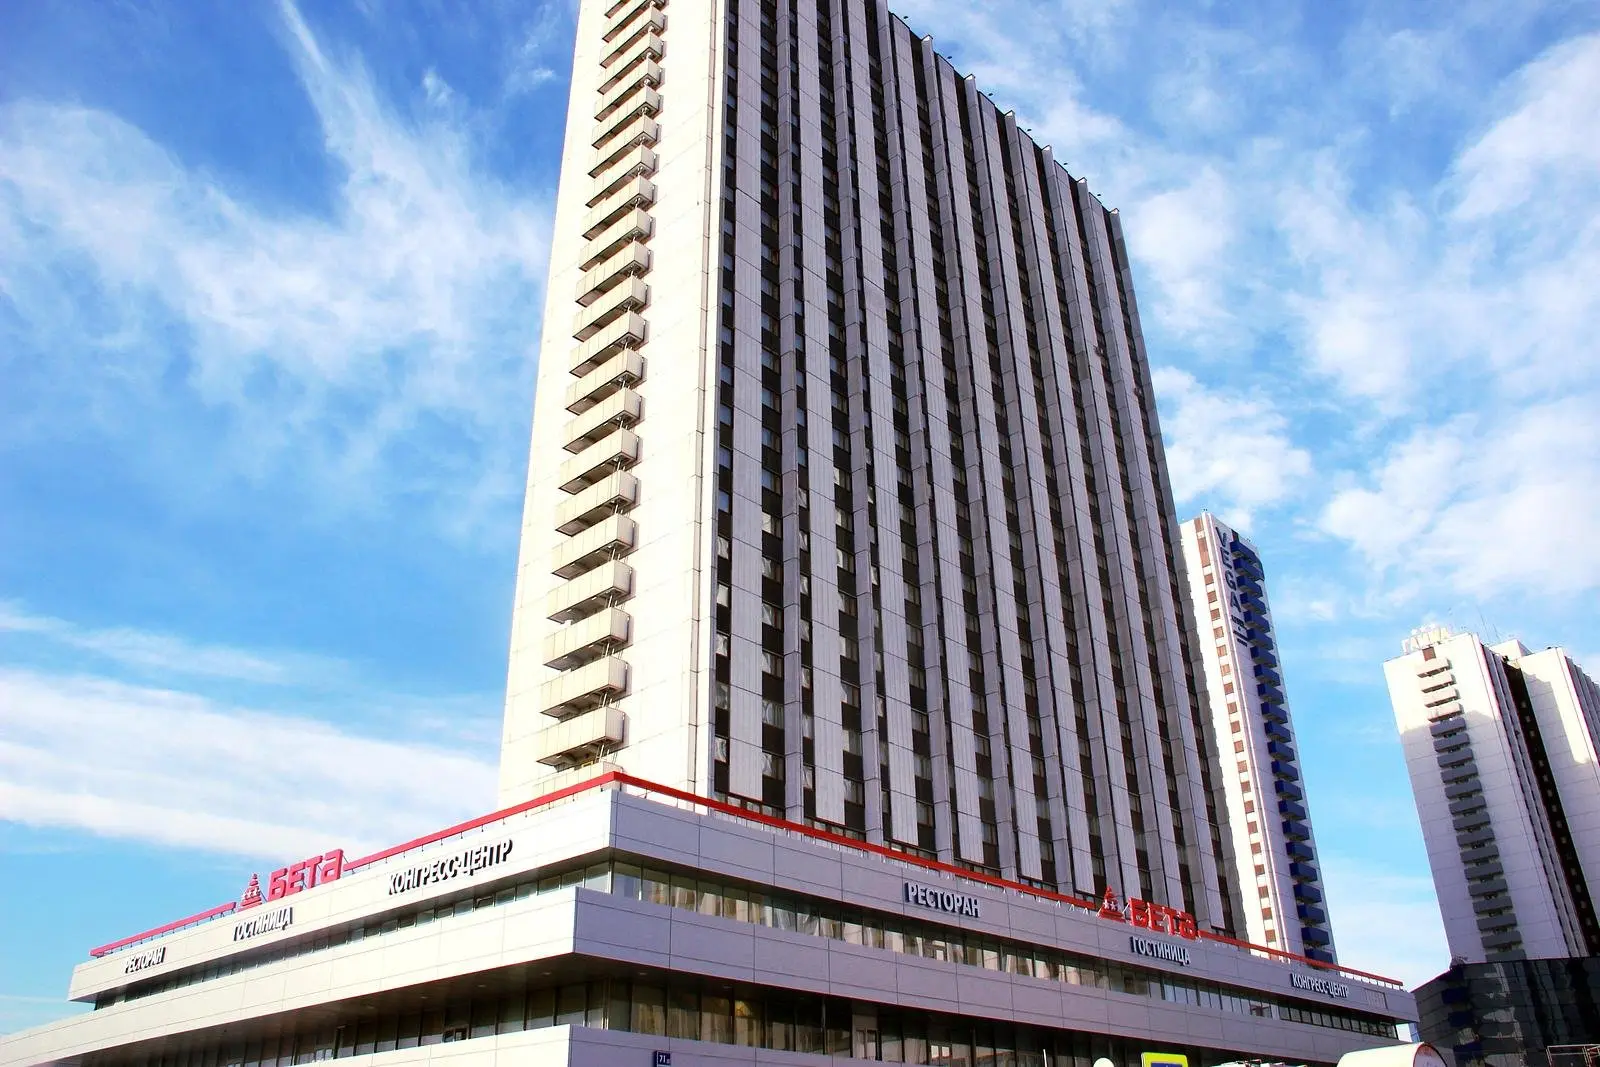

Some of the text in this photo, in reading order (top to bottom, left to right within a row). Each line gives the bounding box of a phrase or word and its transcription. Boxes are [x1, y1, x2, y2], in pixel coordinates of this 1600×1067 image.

[388, 839, 513, 896] КОНГРЕСС-ЦЕНТР
[905, 881, 980, 918] РЕСТОРАН
[233, 906, 293, 941] ГОСТИНИЦА
[125, 946, 166, 974] РЕСТОРАН
[1130, 936, 1191, 966] ГОСТИНИЦА
[1291, 973, 1349, 998] КОНГРЕСС-ЦЕНТР
